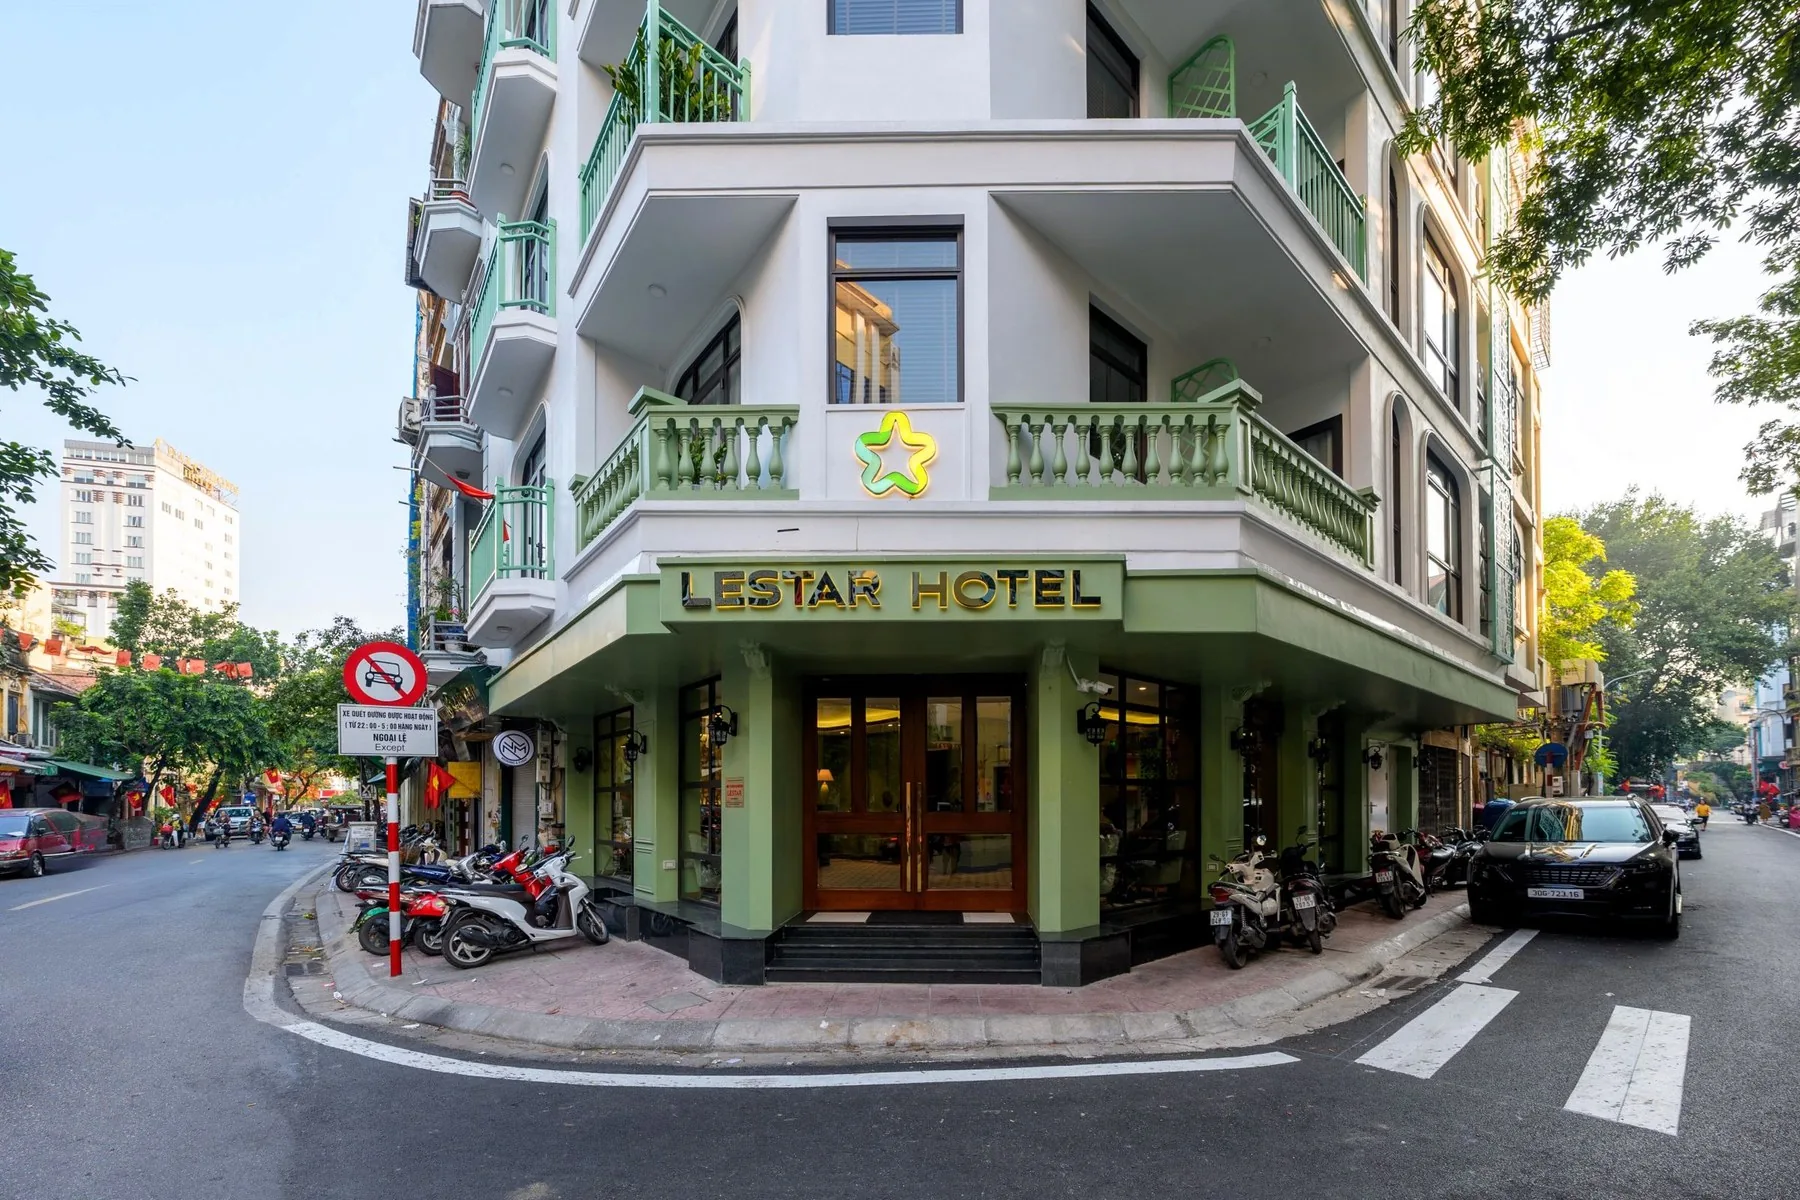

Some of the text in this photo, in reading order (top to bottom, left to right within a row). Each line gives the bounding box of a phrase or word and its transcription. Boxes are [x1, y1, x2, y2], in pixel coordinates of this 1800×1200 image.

[681, 570, 1102, 609] LESTAR HOTEL
[373, 732, 407, 744] NGOẠI LỆ
[375, 743, 406, 752] Except
